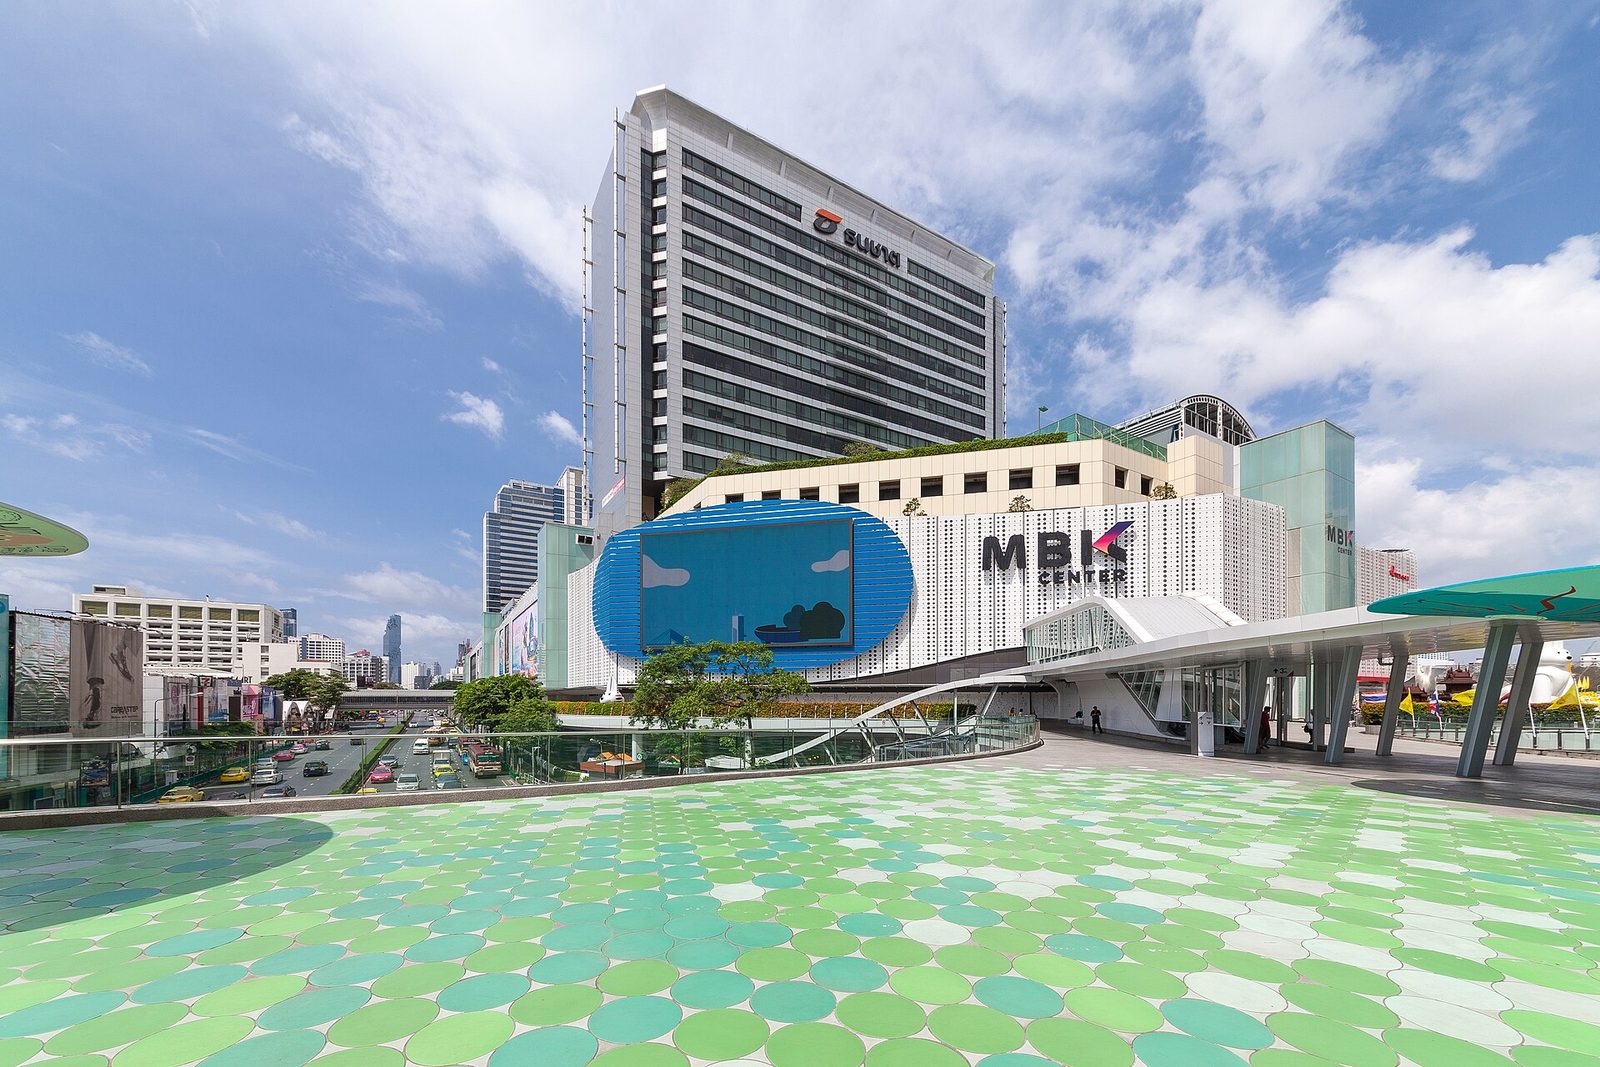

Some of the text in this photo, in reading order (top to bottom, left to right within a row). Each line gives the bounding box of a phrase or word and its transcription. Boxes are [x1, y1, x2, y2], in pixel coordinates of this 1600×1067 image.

[844, 228, 900, 268] ธนชาต
[981, 520, 1135, 571] MBK
[1327, 525, 1353, 547] MBK
[1338, 547, 1353, 556] CENTER
[1037, 568, 1127, 585] CENTER
